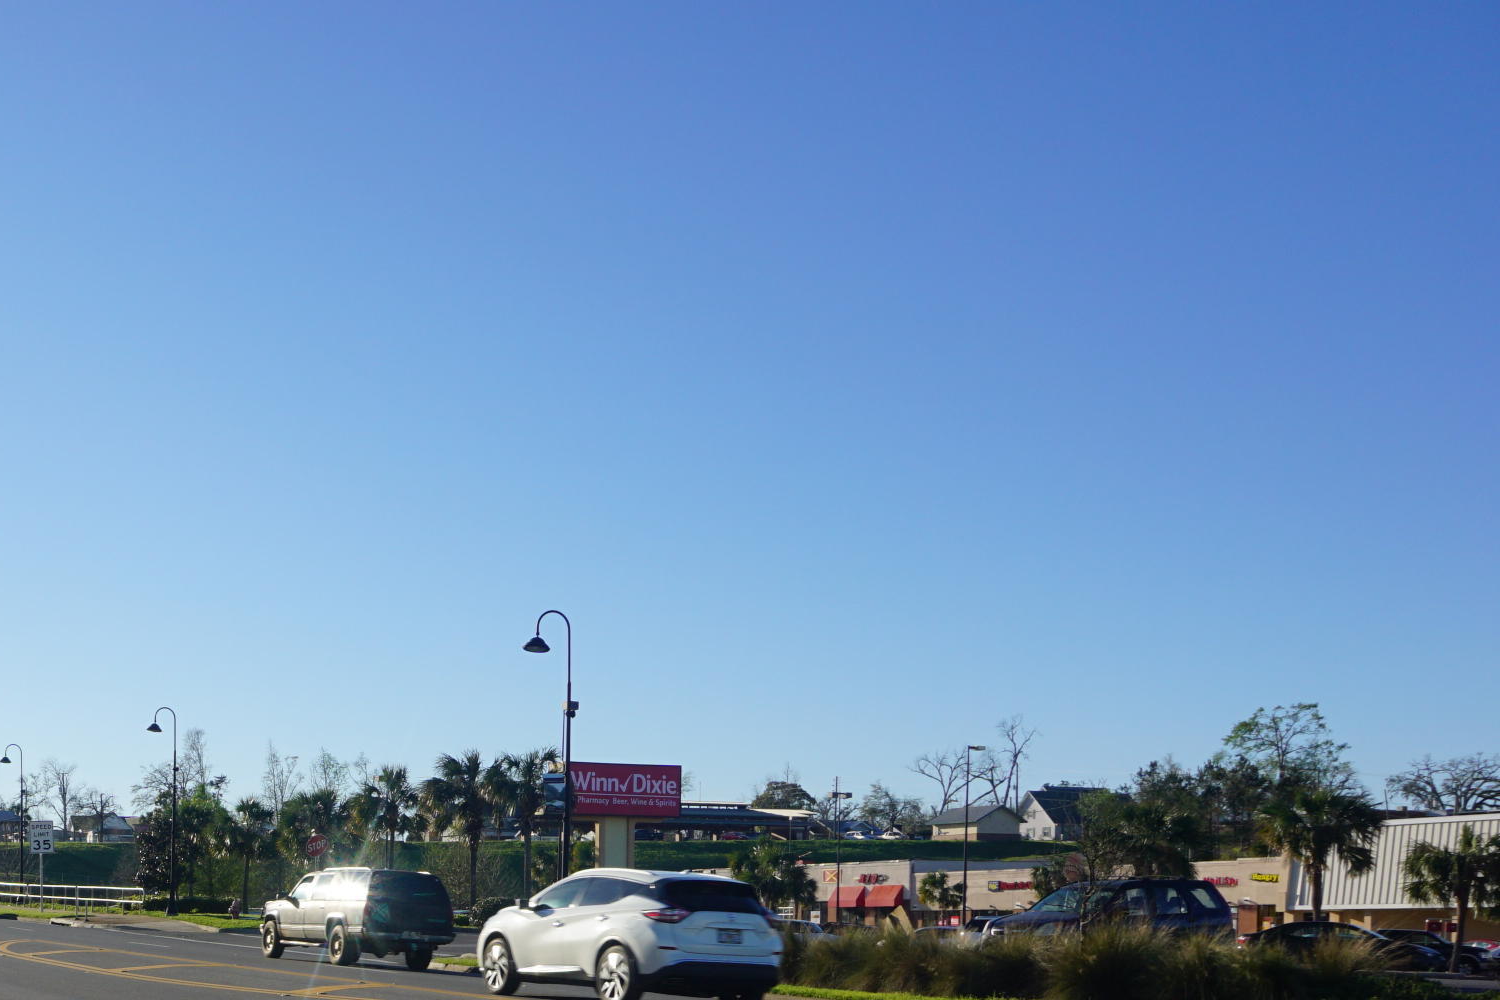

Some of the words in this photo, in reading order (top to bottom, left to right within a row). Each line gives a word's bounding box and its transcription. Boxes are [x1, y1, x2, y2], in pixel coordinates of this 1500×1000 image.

[570, 771, 619, 793] Winn
[632, 773, 677, 795] Dixie
[577, 795, 609, 806] Pharmacy
[612, 797, 629, 806] Beer,
[630, 798, 647, 806] Wine
[655, 799, 677, 808] Spirits
[33, 839, 51, 851] 35
[307, 840, 325, 852] STOP
[1251, 873, 1279, 883] Hungry
